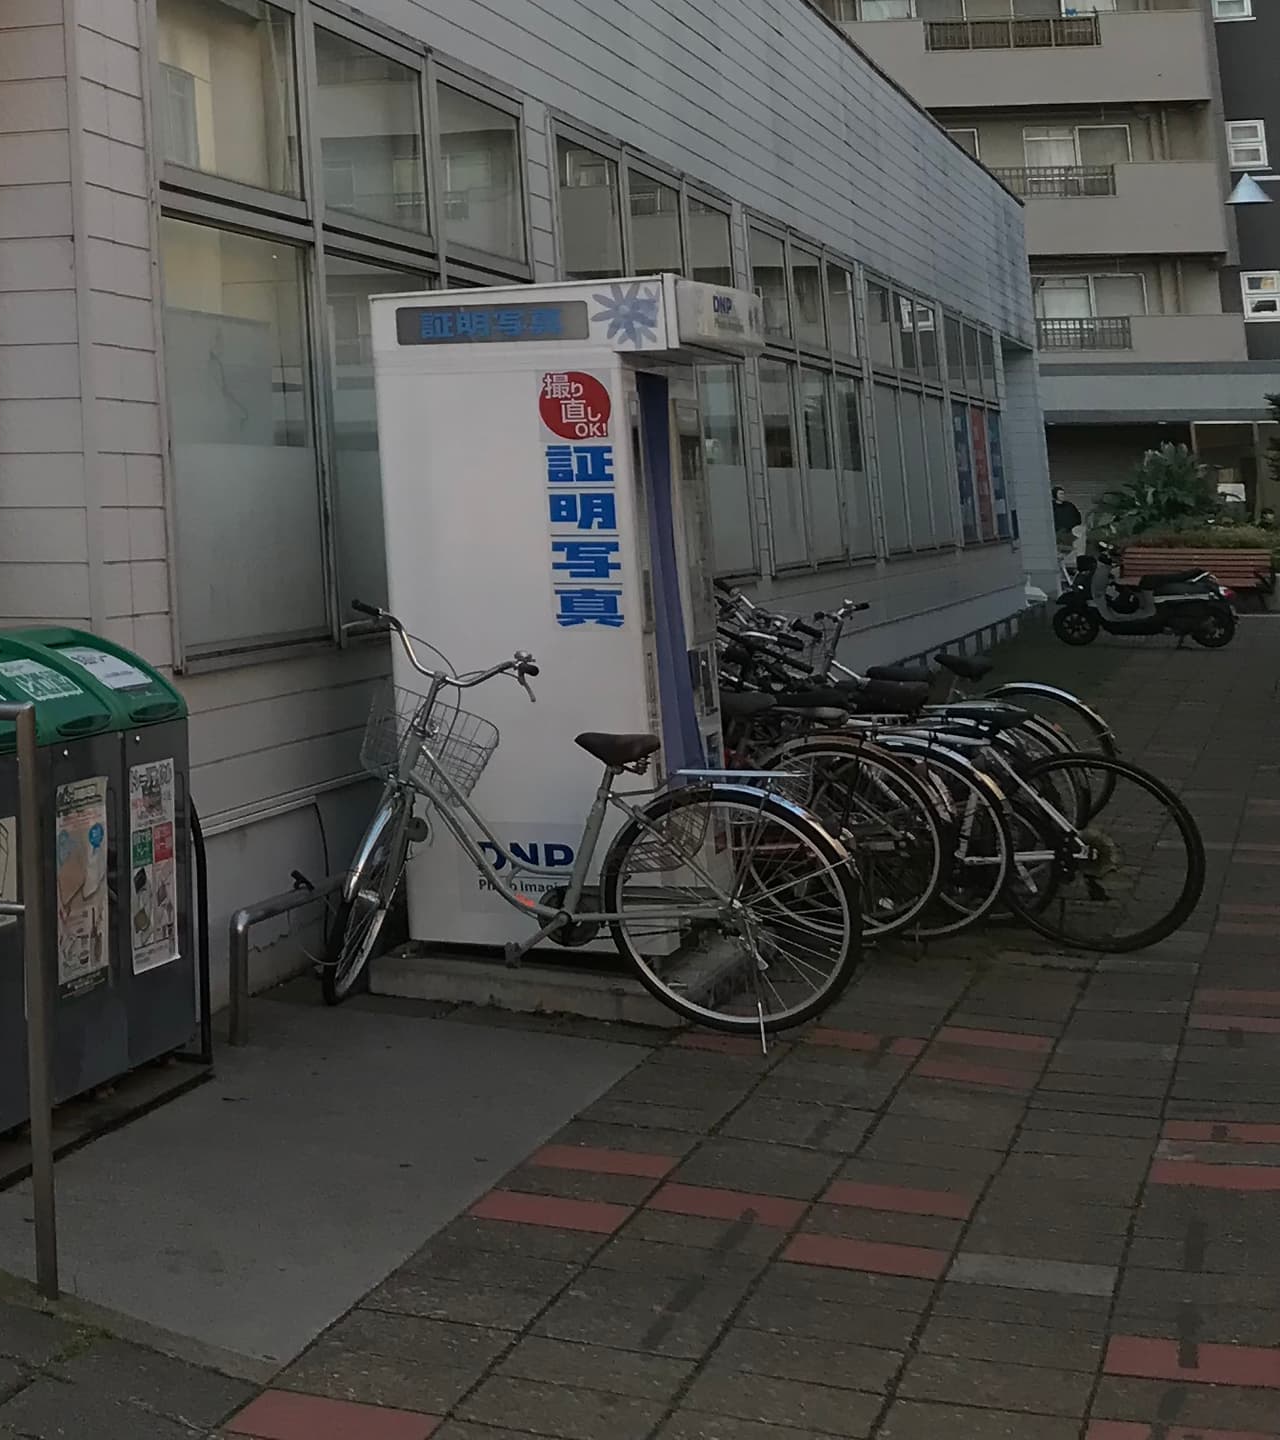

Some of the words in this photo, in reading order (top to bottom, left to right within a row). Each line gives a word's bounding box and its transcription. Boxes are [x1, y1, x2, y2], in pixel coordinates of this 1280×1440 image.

[420, 307, 565, 339] 証明写真
[543, 374, 583, 399] 撮り
[560, 399, 601, 423] 直し
[575, 422, 608, 437] OK!
[544, 444, 625, 629] 証明写真
[479, 880, 517, 891] Pho
